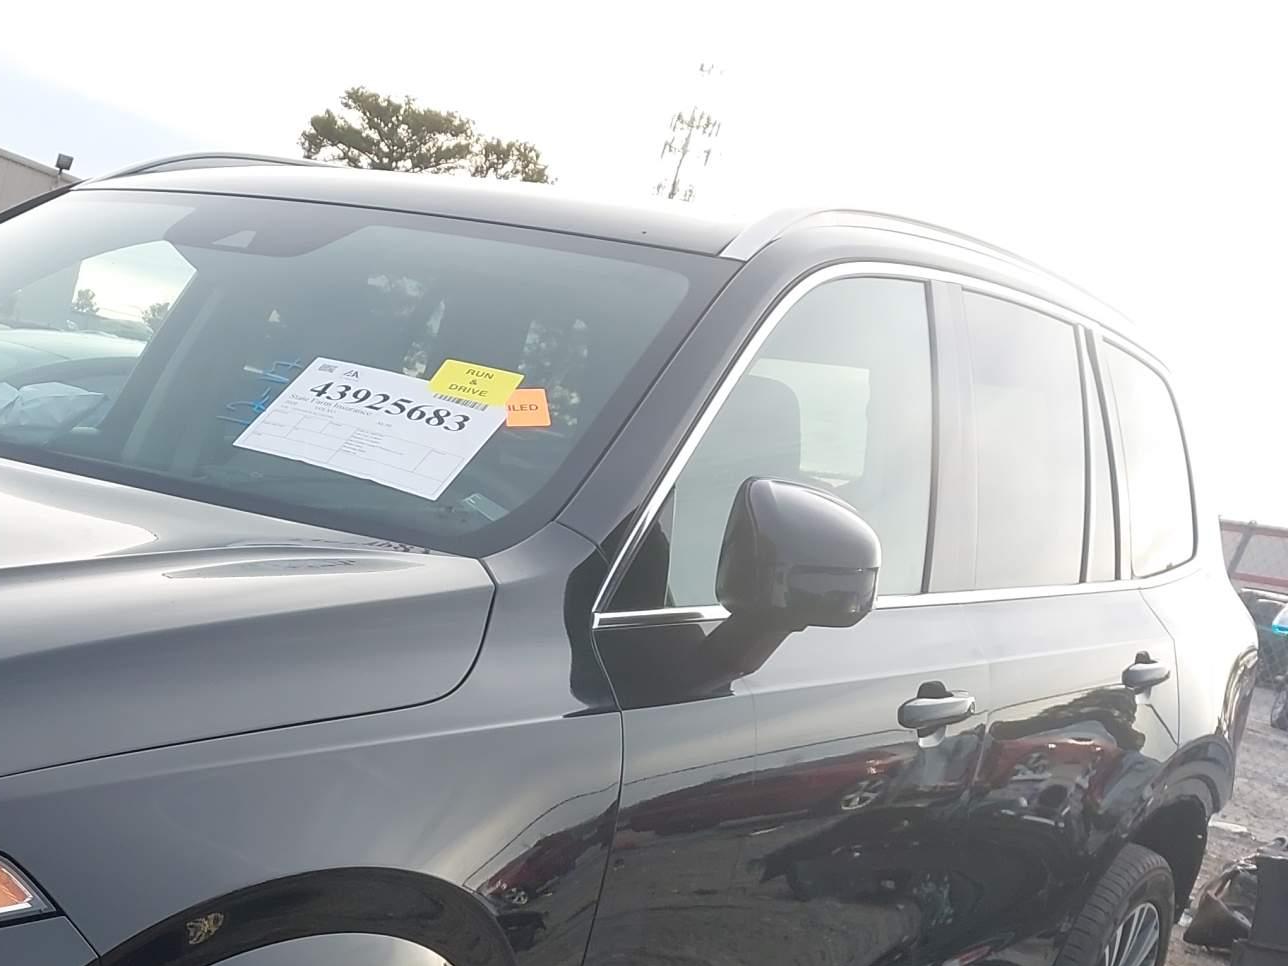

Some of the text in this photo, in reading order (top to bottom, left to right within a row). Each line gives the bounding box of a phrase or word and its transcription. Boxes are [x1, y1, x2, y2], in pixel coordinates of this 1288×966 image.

[465, 368, 495, 380] RUN
[448, 383, 489, 398] DRIVE
[309, 381, 471, 432] 43925683
